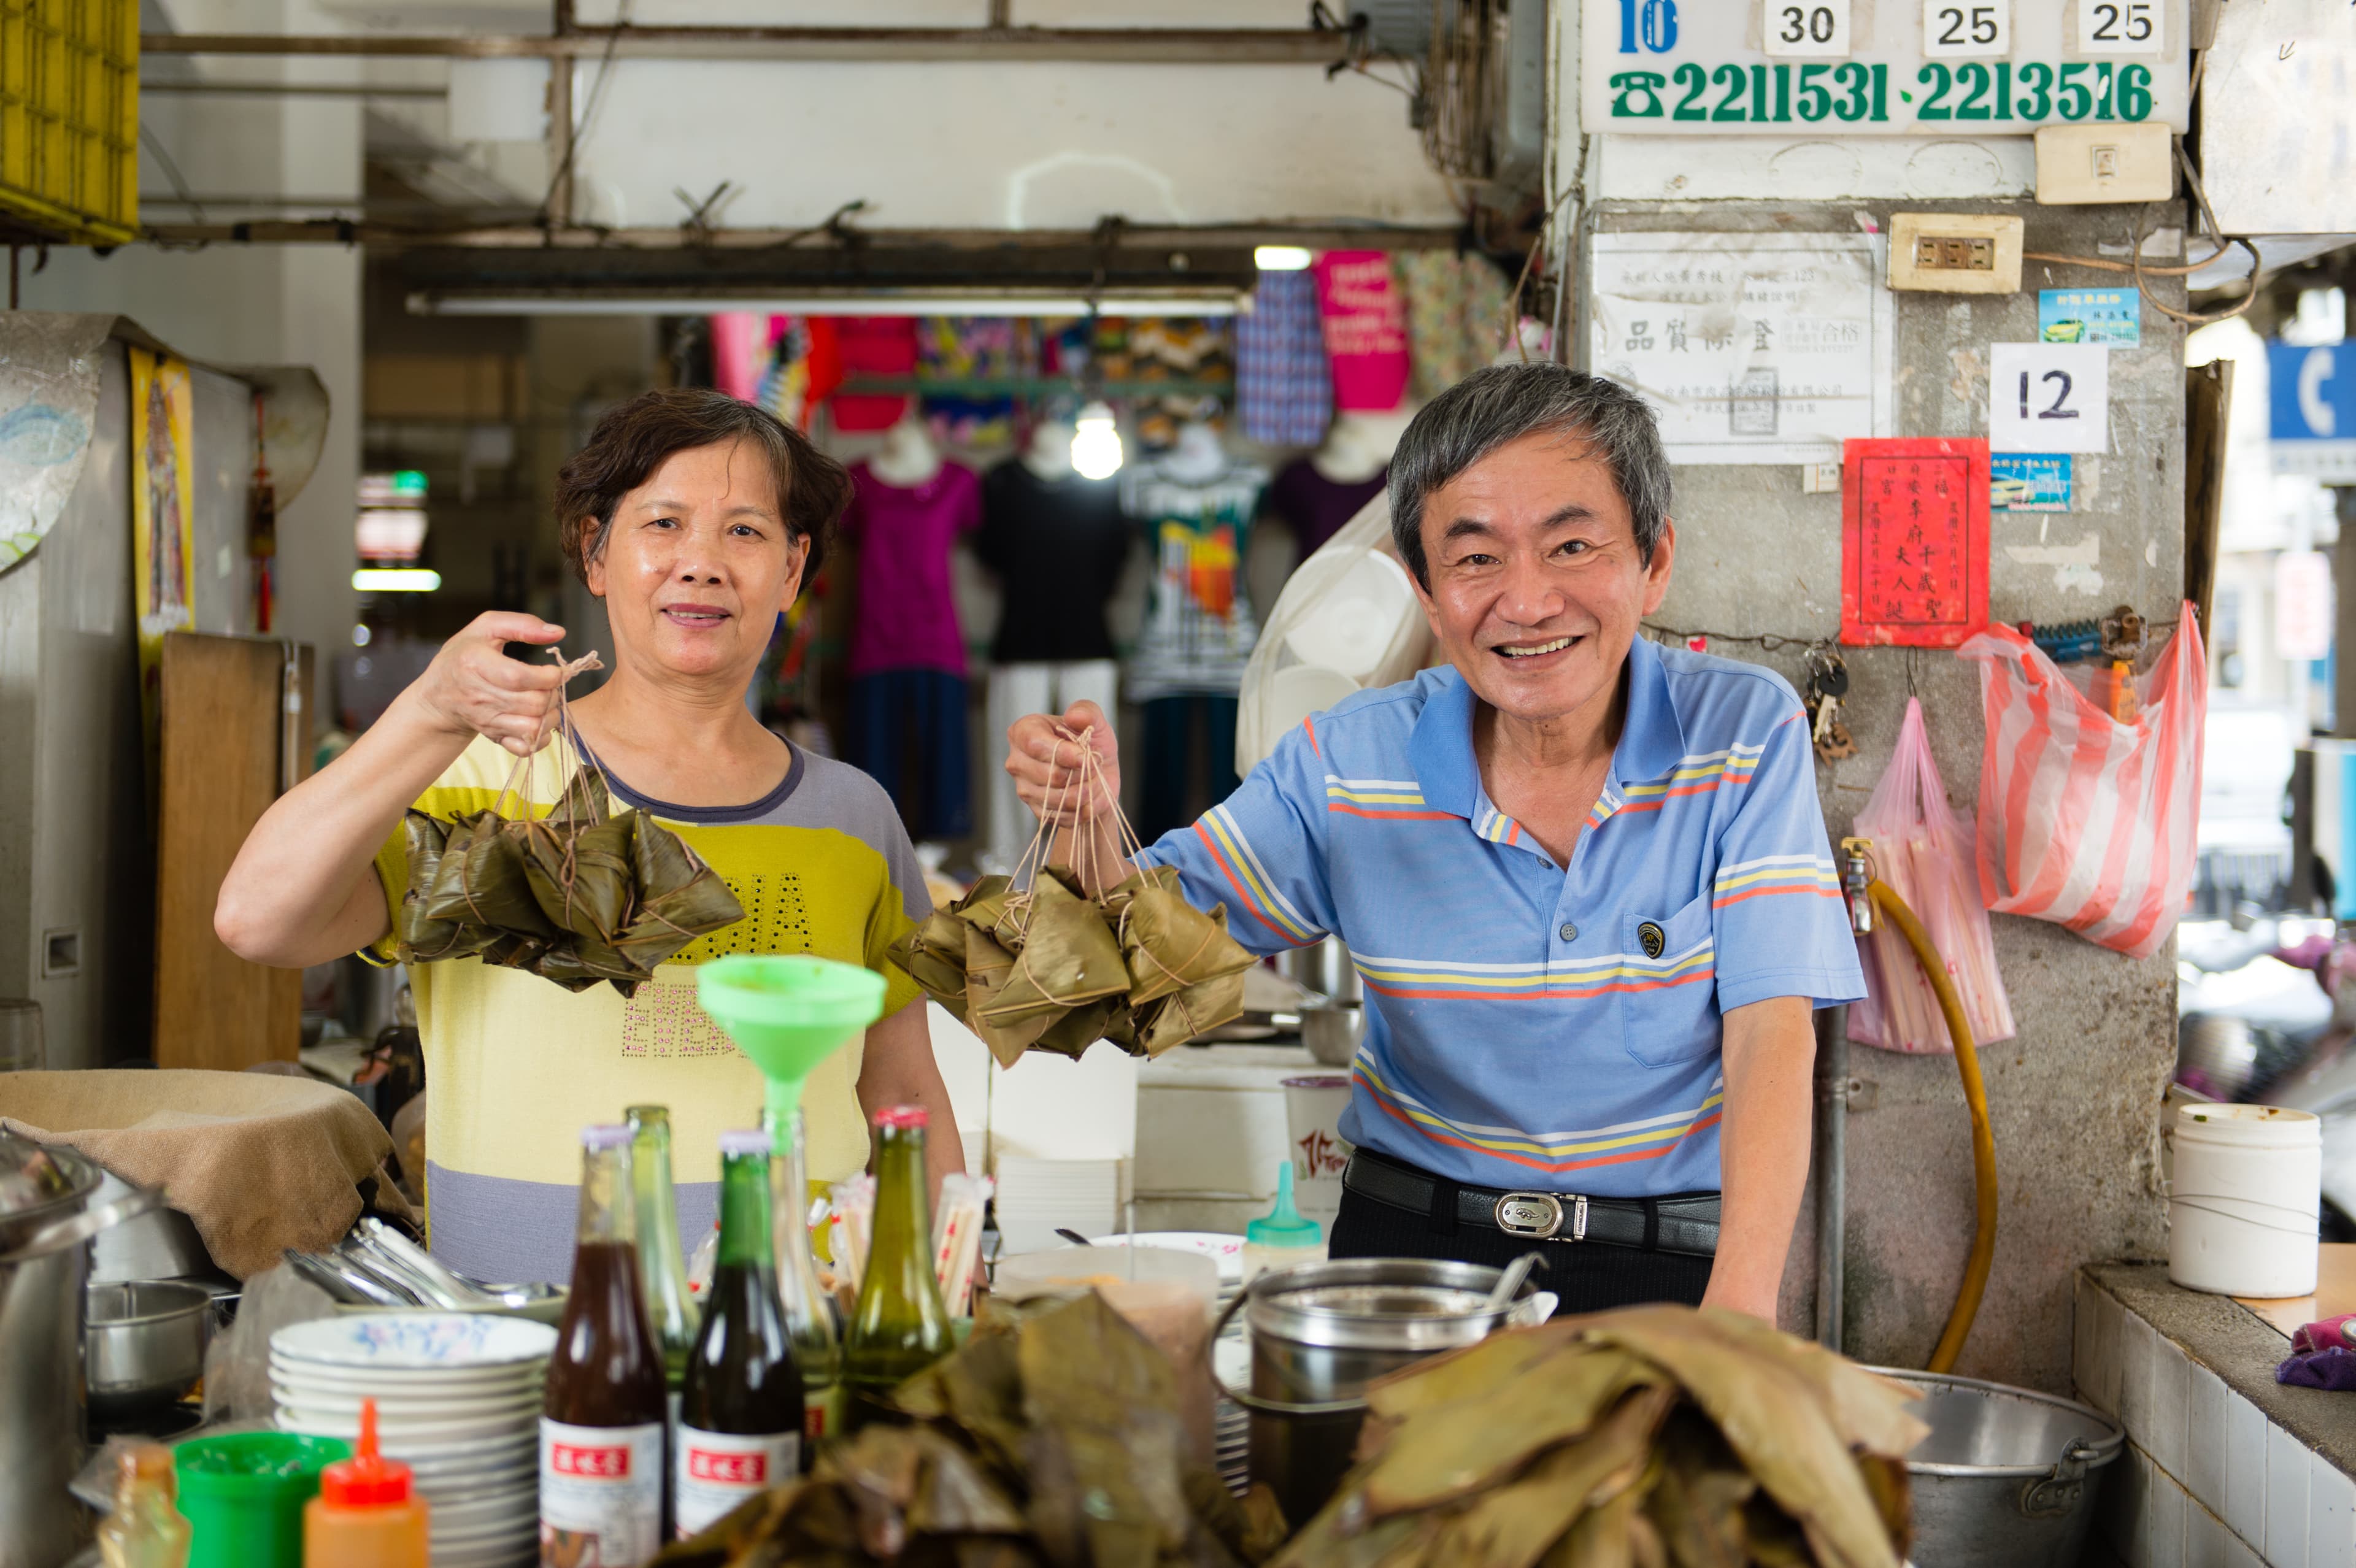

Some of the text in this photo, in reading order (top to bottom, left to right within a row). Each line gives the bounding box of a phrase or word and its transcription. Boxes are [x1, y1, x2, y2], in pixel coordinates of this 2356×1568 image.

[1780, 7, 1834, 43] 30
[1938, 7, 1998, 45] 25
[2093, 4, 2152, 41] 25
[1673, 63, 2152, 121] 2211531 2213516
[2019, 370, 2079, 420] 12
